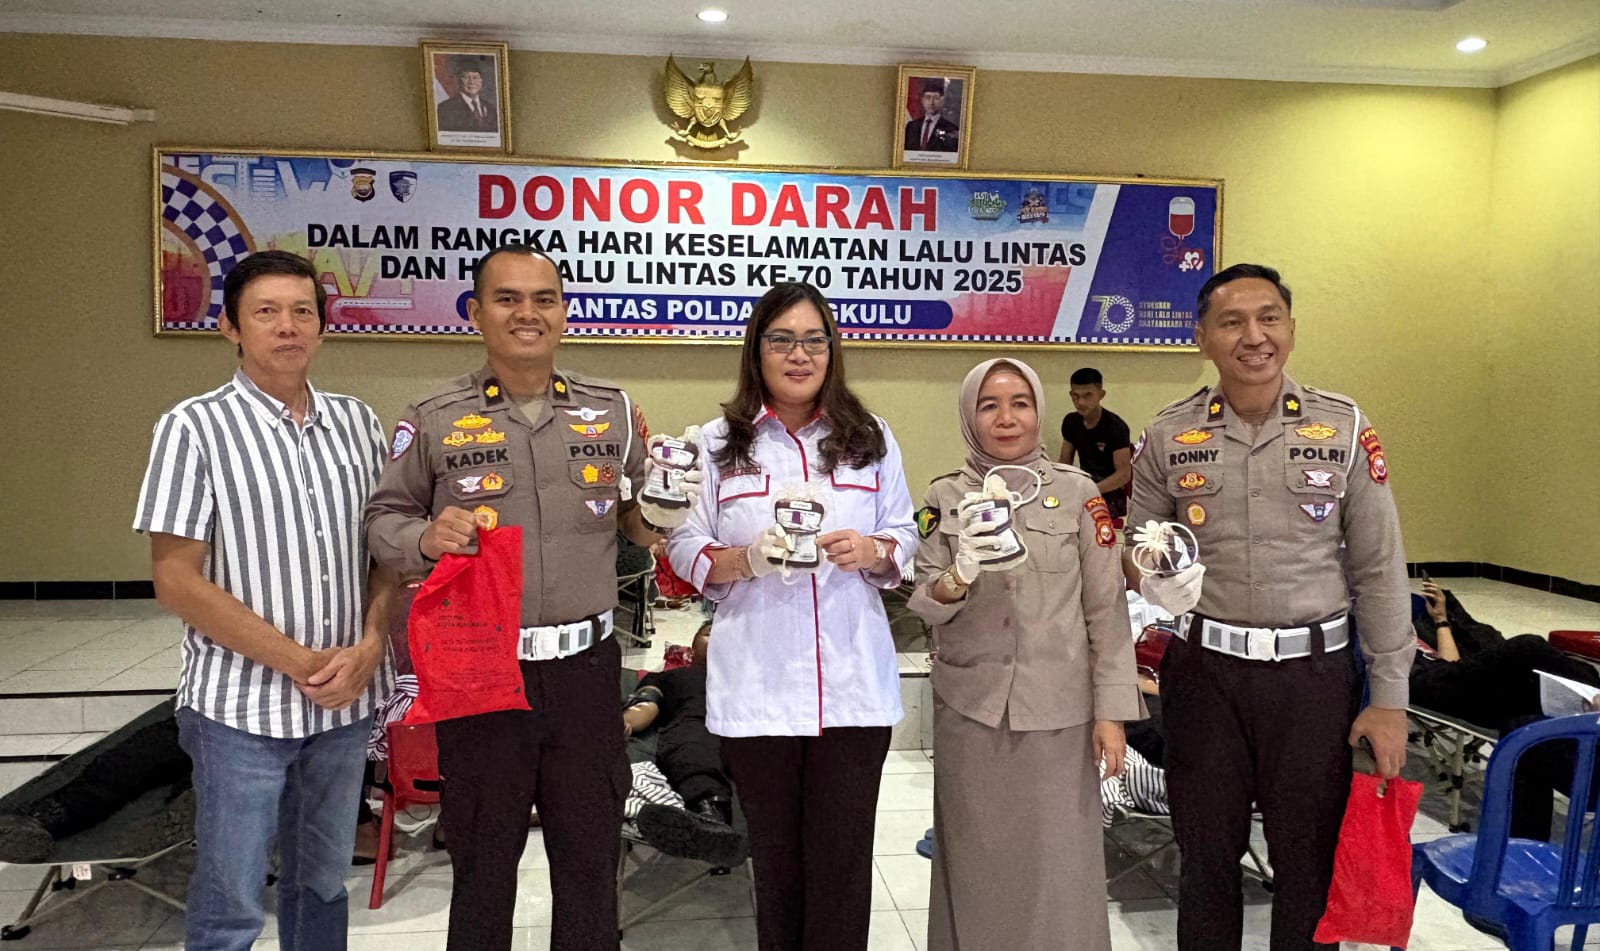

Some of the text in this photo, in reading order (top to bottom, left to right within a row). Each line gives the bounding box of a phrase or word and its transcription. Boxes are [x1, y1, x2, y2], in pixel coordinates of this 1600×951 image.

[478, 174, 938, 231] DONOR DARAH
[307, 224, 1087, 266] DALAM RANGKA HARI KESELAMATAN LALU LINTAS
[381, 255, 446, 280] DAN
[560, 259, 616, 284] ALU
[627, 261, 736, 286] LINTAS
[747, 264, 832, 288] KE-70
[841, 267, 944, 291] TAHUN
[953, 269, 1023, 293] 2025
[566, 297, 912, 325] ANTAS POLDA GKULU
[1091, 294, 1136, 333] 70
[445, 448, 509, 470] KADEK
[570, 443, 621, 458] POLRI
[1169, 449, 1219, 466] RONNY
[1289, 447, 1345, 464] POLRI
